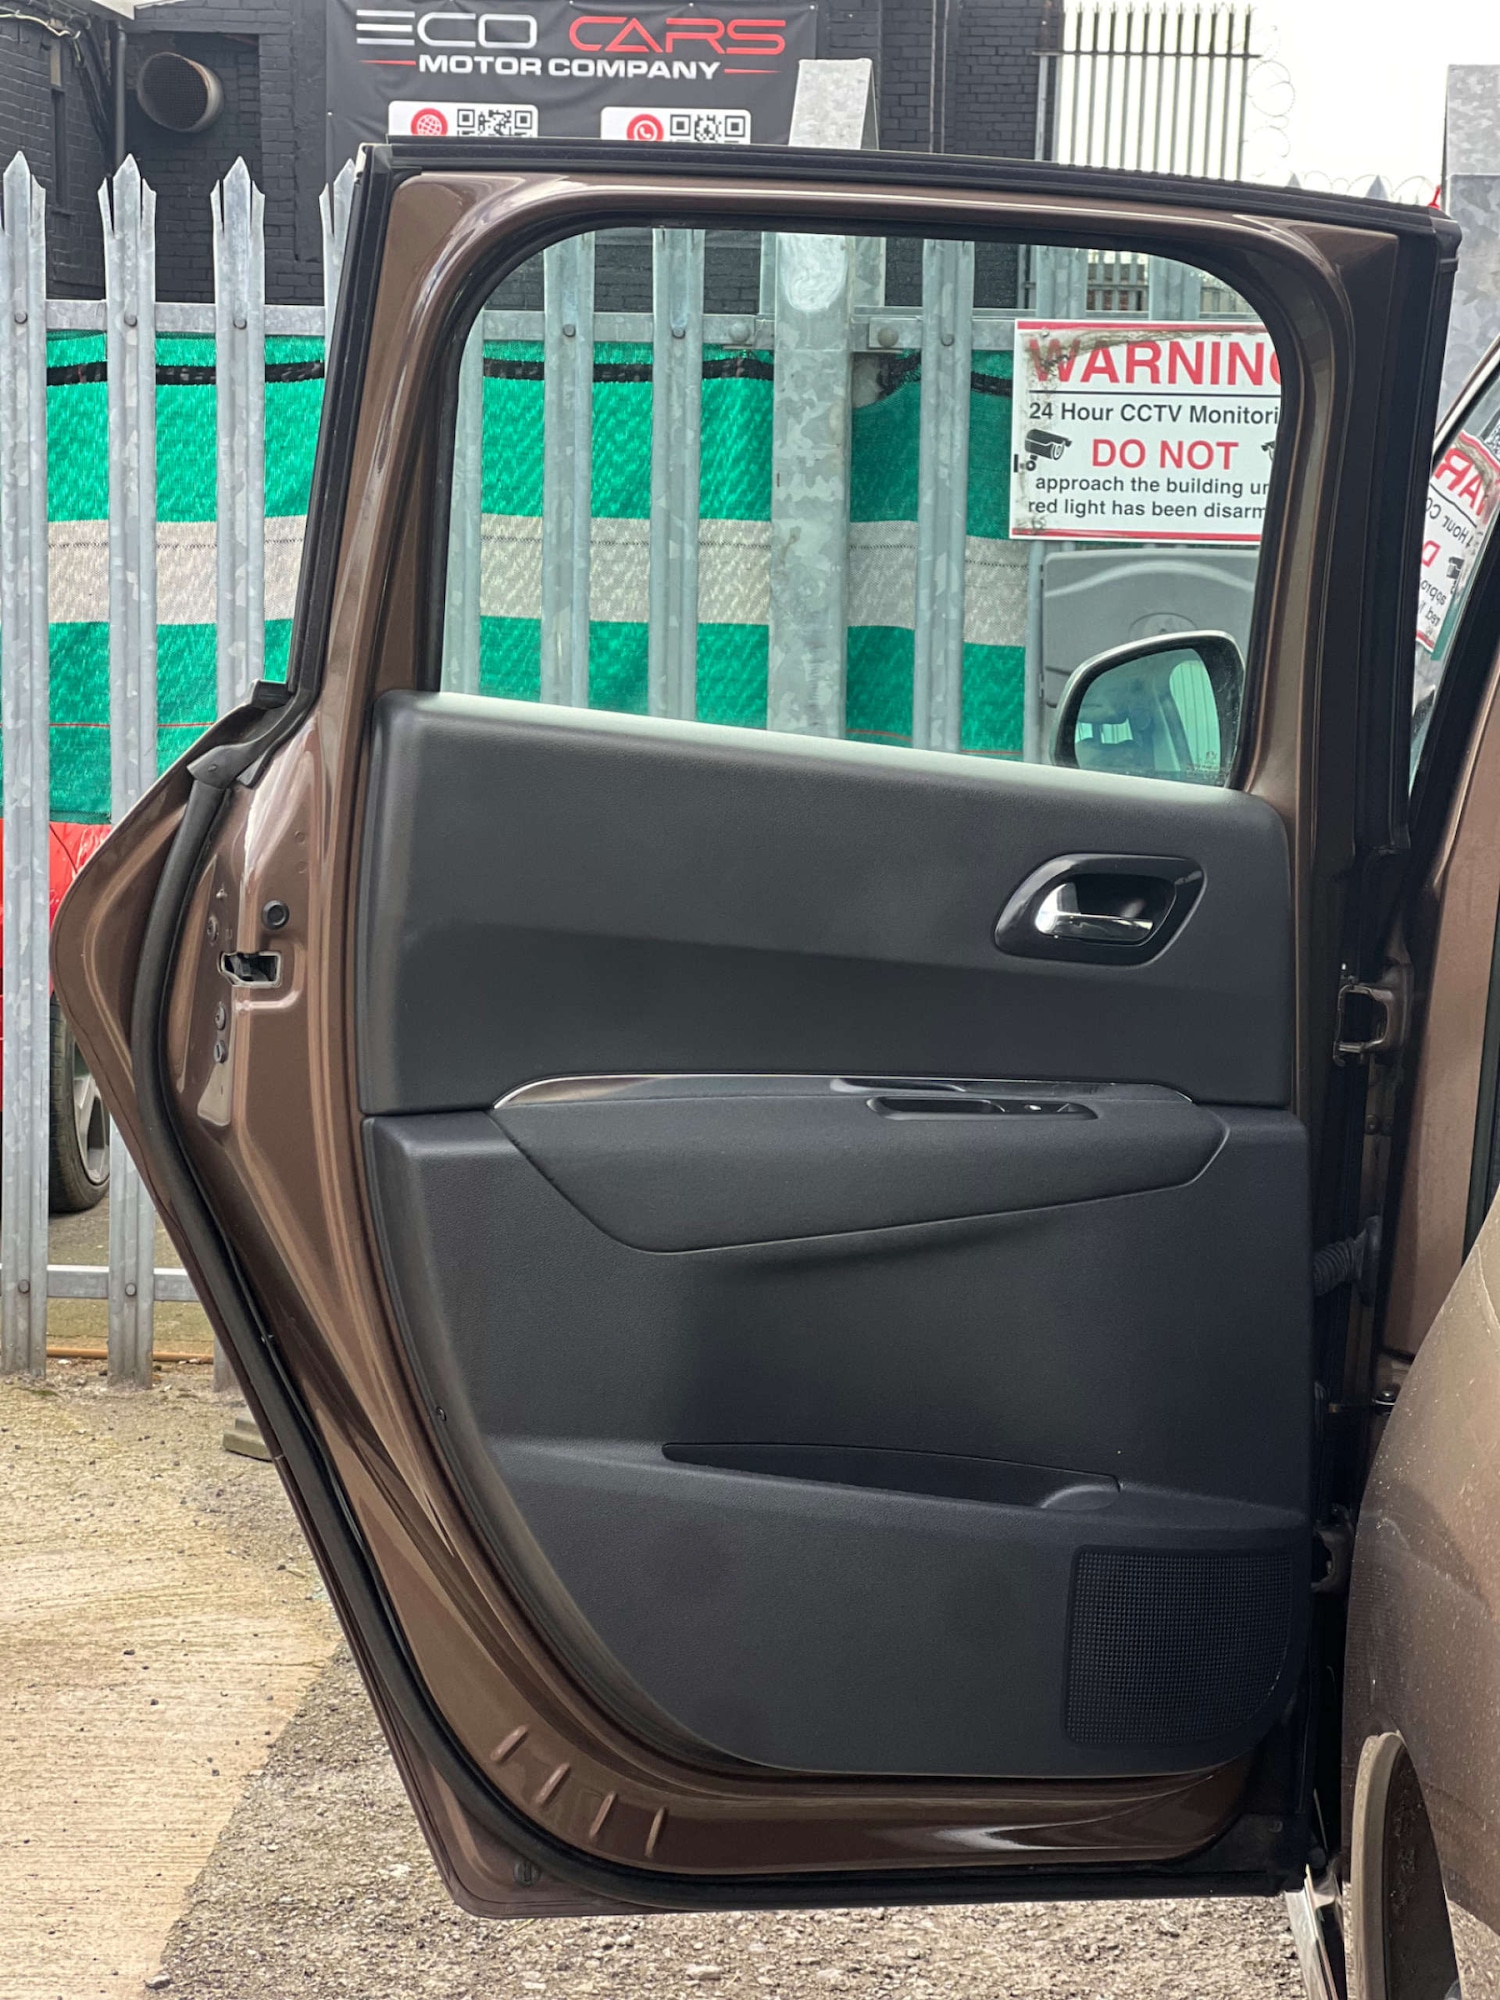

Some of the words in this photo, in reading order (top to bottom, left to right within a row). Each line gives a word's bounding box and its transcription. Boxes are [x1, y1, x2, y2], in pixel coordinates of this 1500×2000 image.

[356, 10, 537, 48] ECO
[569, 16, 786, 55] CARS
[418, 54, 541, 76] MOTOR
[547, 60, 720, 80] COMPANY
[1028, 338, 1281, 386] WARNIN
[1028, 402, 1053, 420] 24
[1061, 403, 1113, 421] Hour
[1120, 404, 1182, 422] CCTV
[1092, 438, 1146, 468] DO
[1159, 440, 1239, 470] NOT
[1035, 475, 1124, 494] approach
[1131, 476, 1160, 493] the
[1166, 477, 1243, 498] building
[1027, 498, 1058, 514] red
[1064, 499, 1106, 518] light
[1112, 500, 1145, 516] has
[1151, 501, 1197, 518] been
